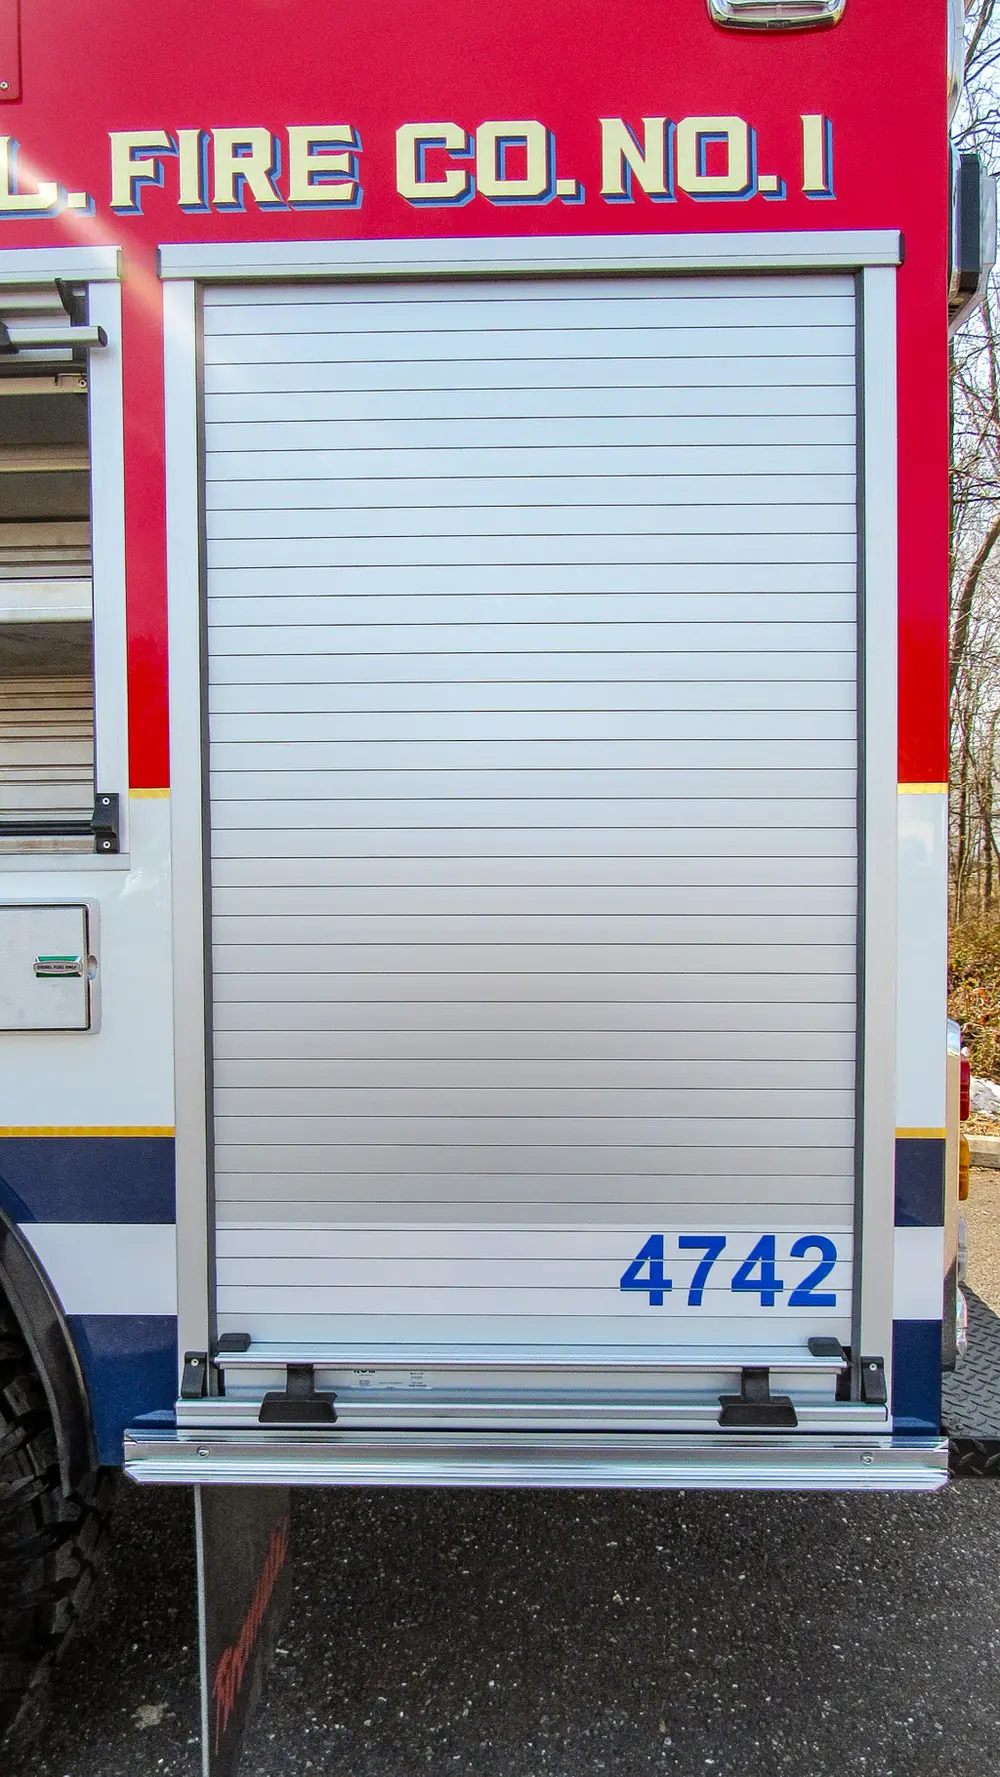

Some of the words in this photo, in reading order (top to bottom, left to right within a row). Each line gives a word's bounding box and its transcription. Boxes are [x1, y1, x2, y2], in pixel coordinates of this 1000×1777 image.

[108, 125, 363, 215] FIRE
[396, 120, 585, 208] CO.
[599, 116, 787, 204] NO.
[620, 1234, 837, 1307] 4742
